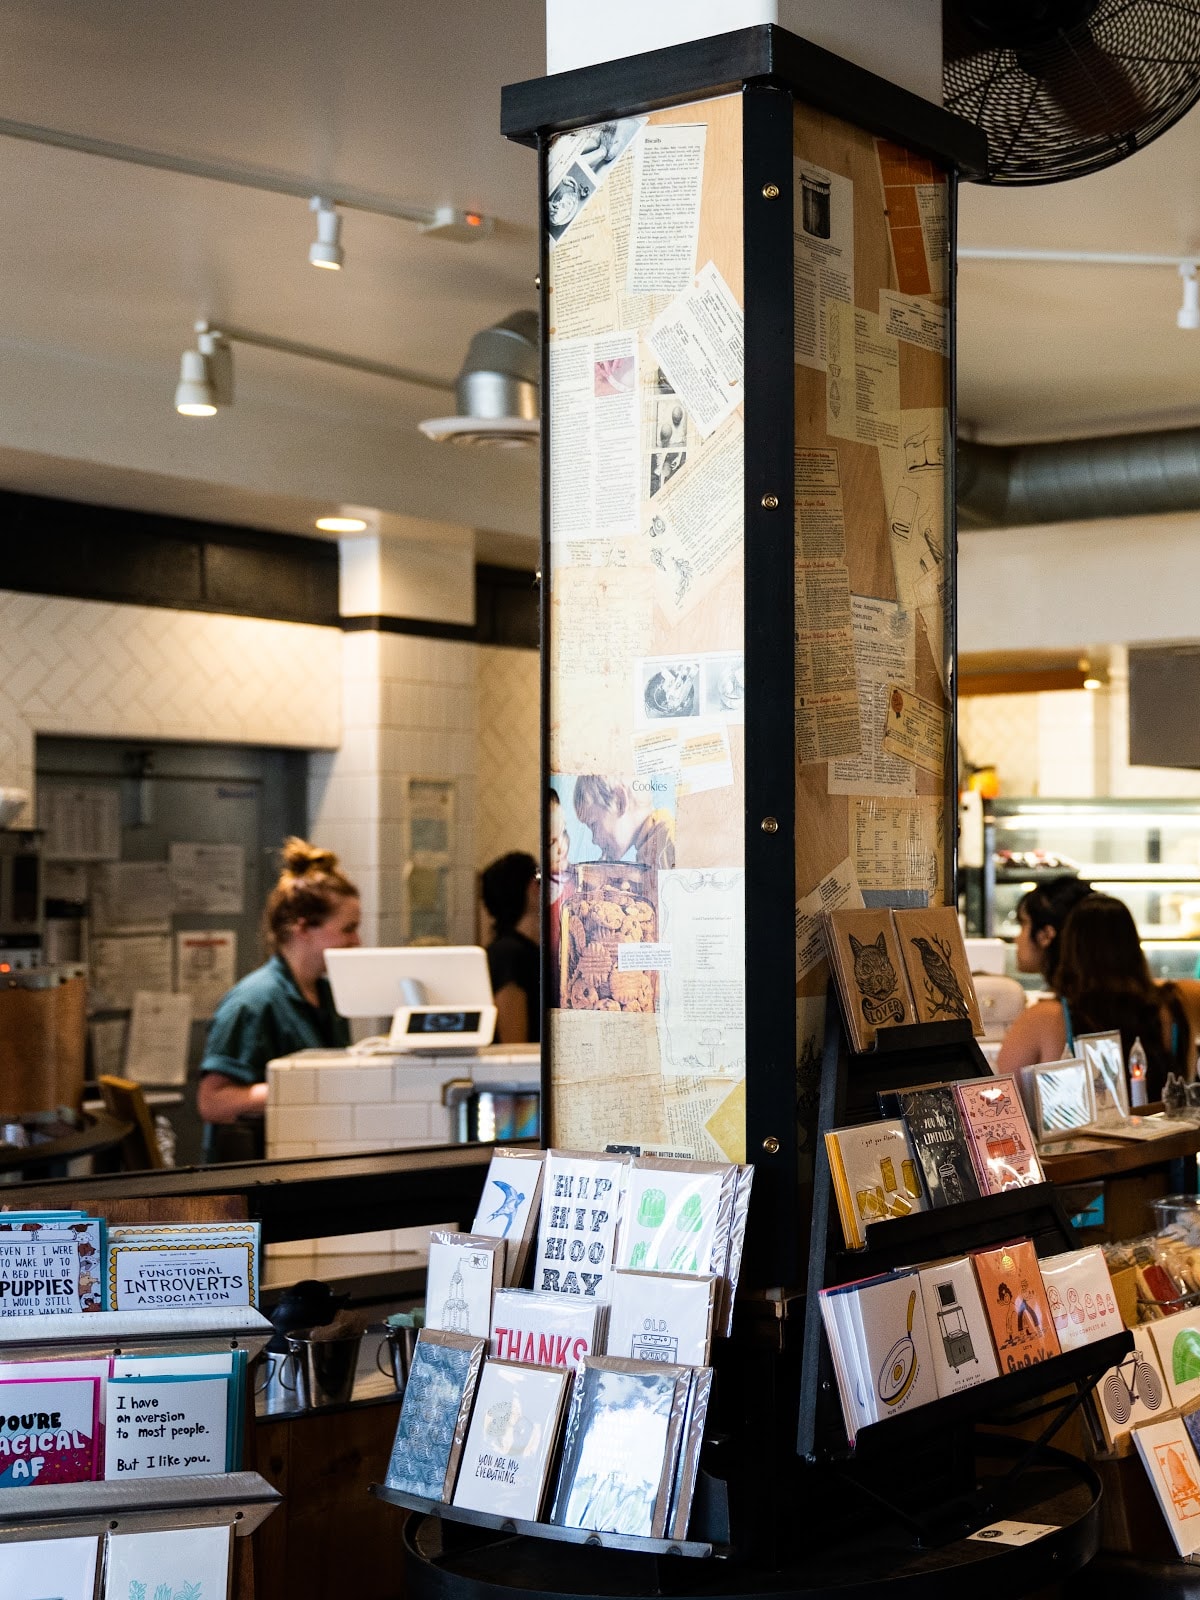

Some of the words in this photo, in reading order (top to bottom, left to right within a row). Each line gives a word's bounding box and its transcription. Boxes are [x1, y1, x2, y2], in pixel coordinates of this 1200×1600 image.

[632, 779, 668, 791] Cookies
[870, 1000, 900, 1022] LOVER
[924, 1117, 935, 1129] YOU
[923, 1129, 955, 1145] LIMITLESS
[553, 1174, 612, 1200] HIP
[550, 1205, 609, 1232] HIP
[0, 1246, 21, 1256] EVEN
[27, 1246, 36, 1256] IF
[42, 1246, 46, 1256] I
[52, 1245, 74, 1255] WERE
[544, 1237, 605, 1264] HOO
[0, 1258, 11, 1268] TO
[15, 1258, 38, 1268] WAKE
[43, 1257, 54, 1267] UP
[59, 1257, 70, 1266] TO
[2, 1270, 8, 1279] A
[12, 1270, 29, 1279] BED
[33, 1269, 54, 1278] FULL
[61, 1268, 71, 1277] OF
[138, 1266, 223, 1278] FUNCTIONAL
[0, 1279, 74, 1297] PUPPIES
[123, 1275, 243, 1295] INTROVERTS
[541, 1268, 602, 1297] RAY
[3, 1299, 7, 1307] I
[12, 1297, 40, 1307] WOULD
[45, 1296, 72, 1306] STILL
[137, 1291, 230, 1304] ASSOCIATION
[1, 1308, 34, 1317] PREFER
[39, 1307, 73, 1315] WAKING
[495, 1327, 588, 1366] THANKS
[116, 1396, 126, 1410] I
[131, 1396, 159, 1410] have
[116, 1414, 130, 1423] an
[135, 1411, 185, 1423] aversion
[116, 1427, 128, 1439] to
[138, 1424, 166, 1438] most
[171, 1422, 210, 1440] people.
[0, 1429, 86, 1456] AGICAL
[12, 1456, 45, 1479] AF
[117, 1458, 139, 1471] But
[147, 1456, 155, 1469] I
[158, 1455, 180, 1467] like
[184, 1455, 211, 1468] you.
[478, 1454, 493, 1466] YOU
[494, 1457, 506, 1469] ARE
[508, 1458, 519, 1472] MY
